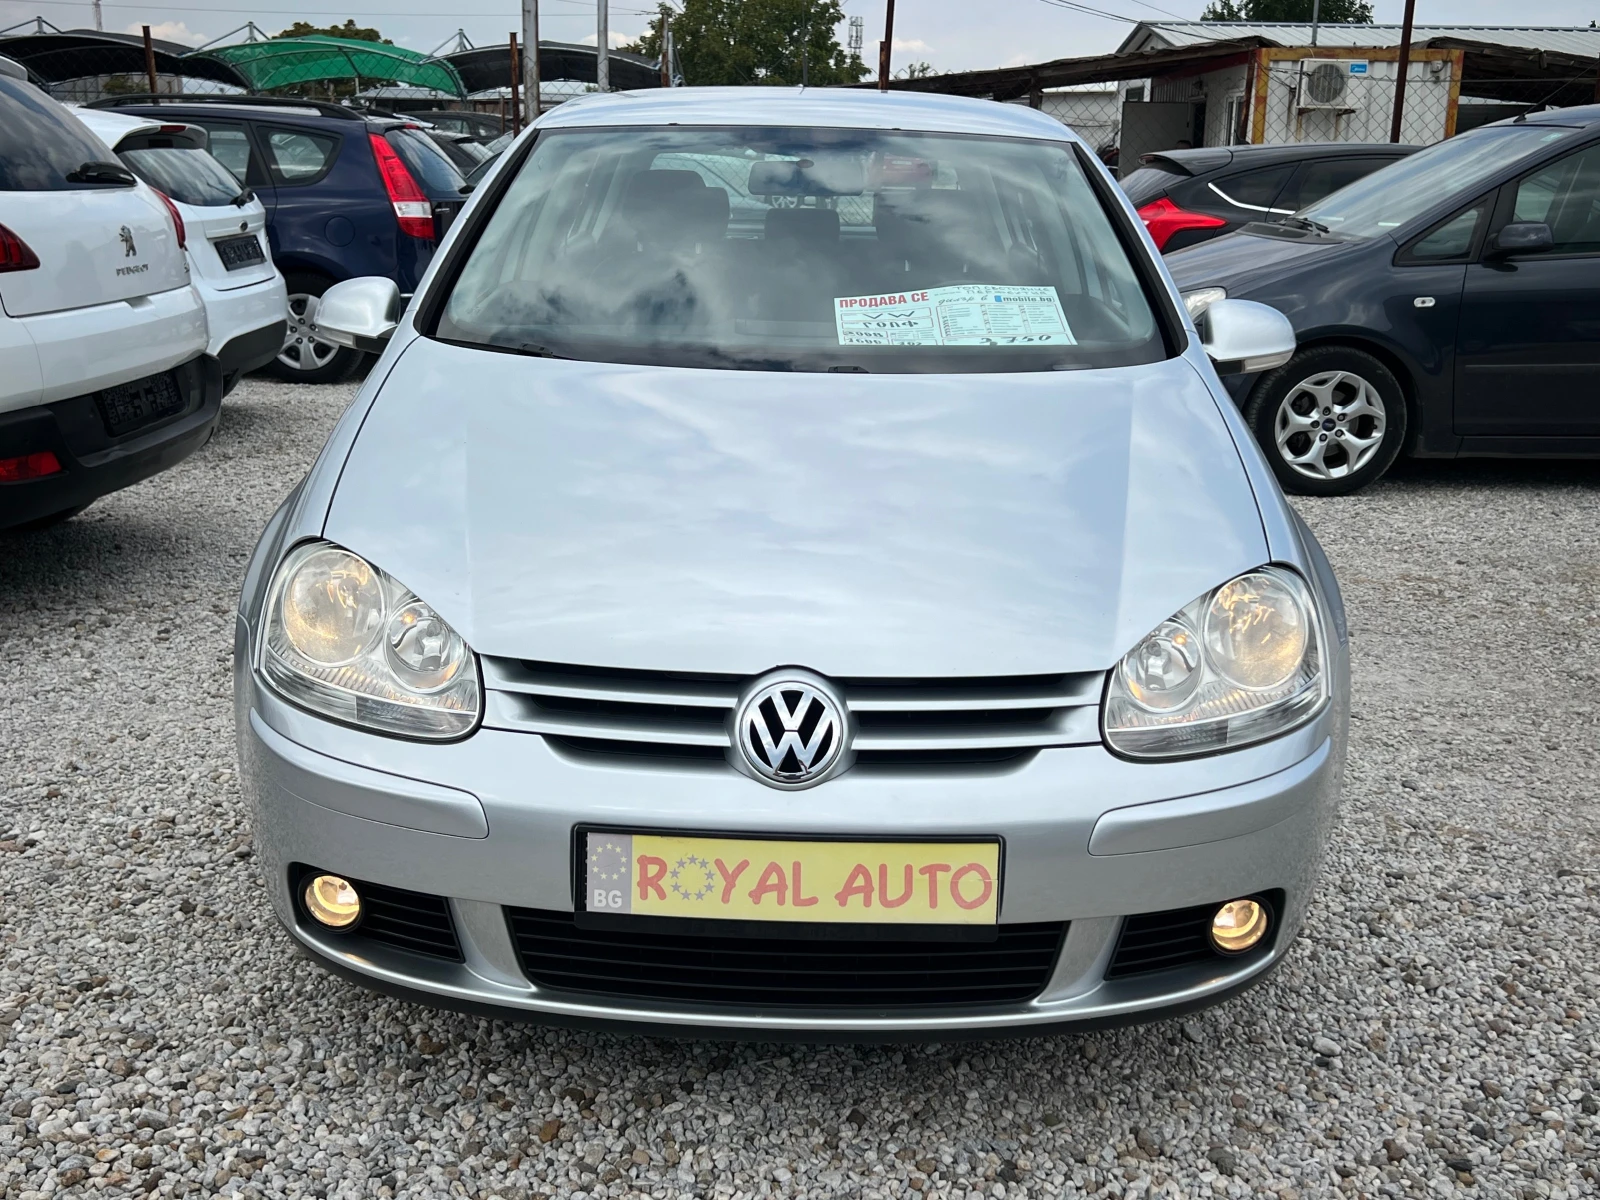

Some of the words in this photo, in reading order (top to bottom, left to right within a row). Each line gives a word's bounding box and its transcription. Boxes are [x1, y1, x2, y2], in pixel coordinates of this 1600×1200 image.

[839, 294, 907, 308] ПРОДАВА
[911, 291, 930, 302] СЕ
[636, 854, 819, 907] ROYAL
[834, 862, 993, 910] AUTO
[592, 889, 624, 908] BG
